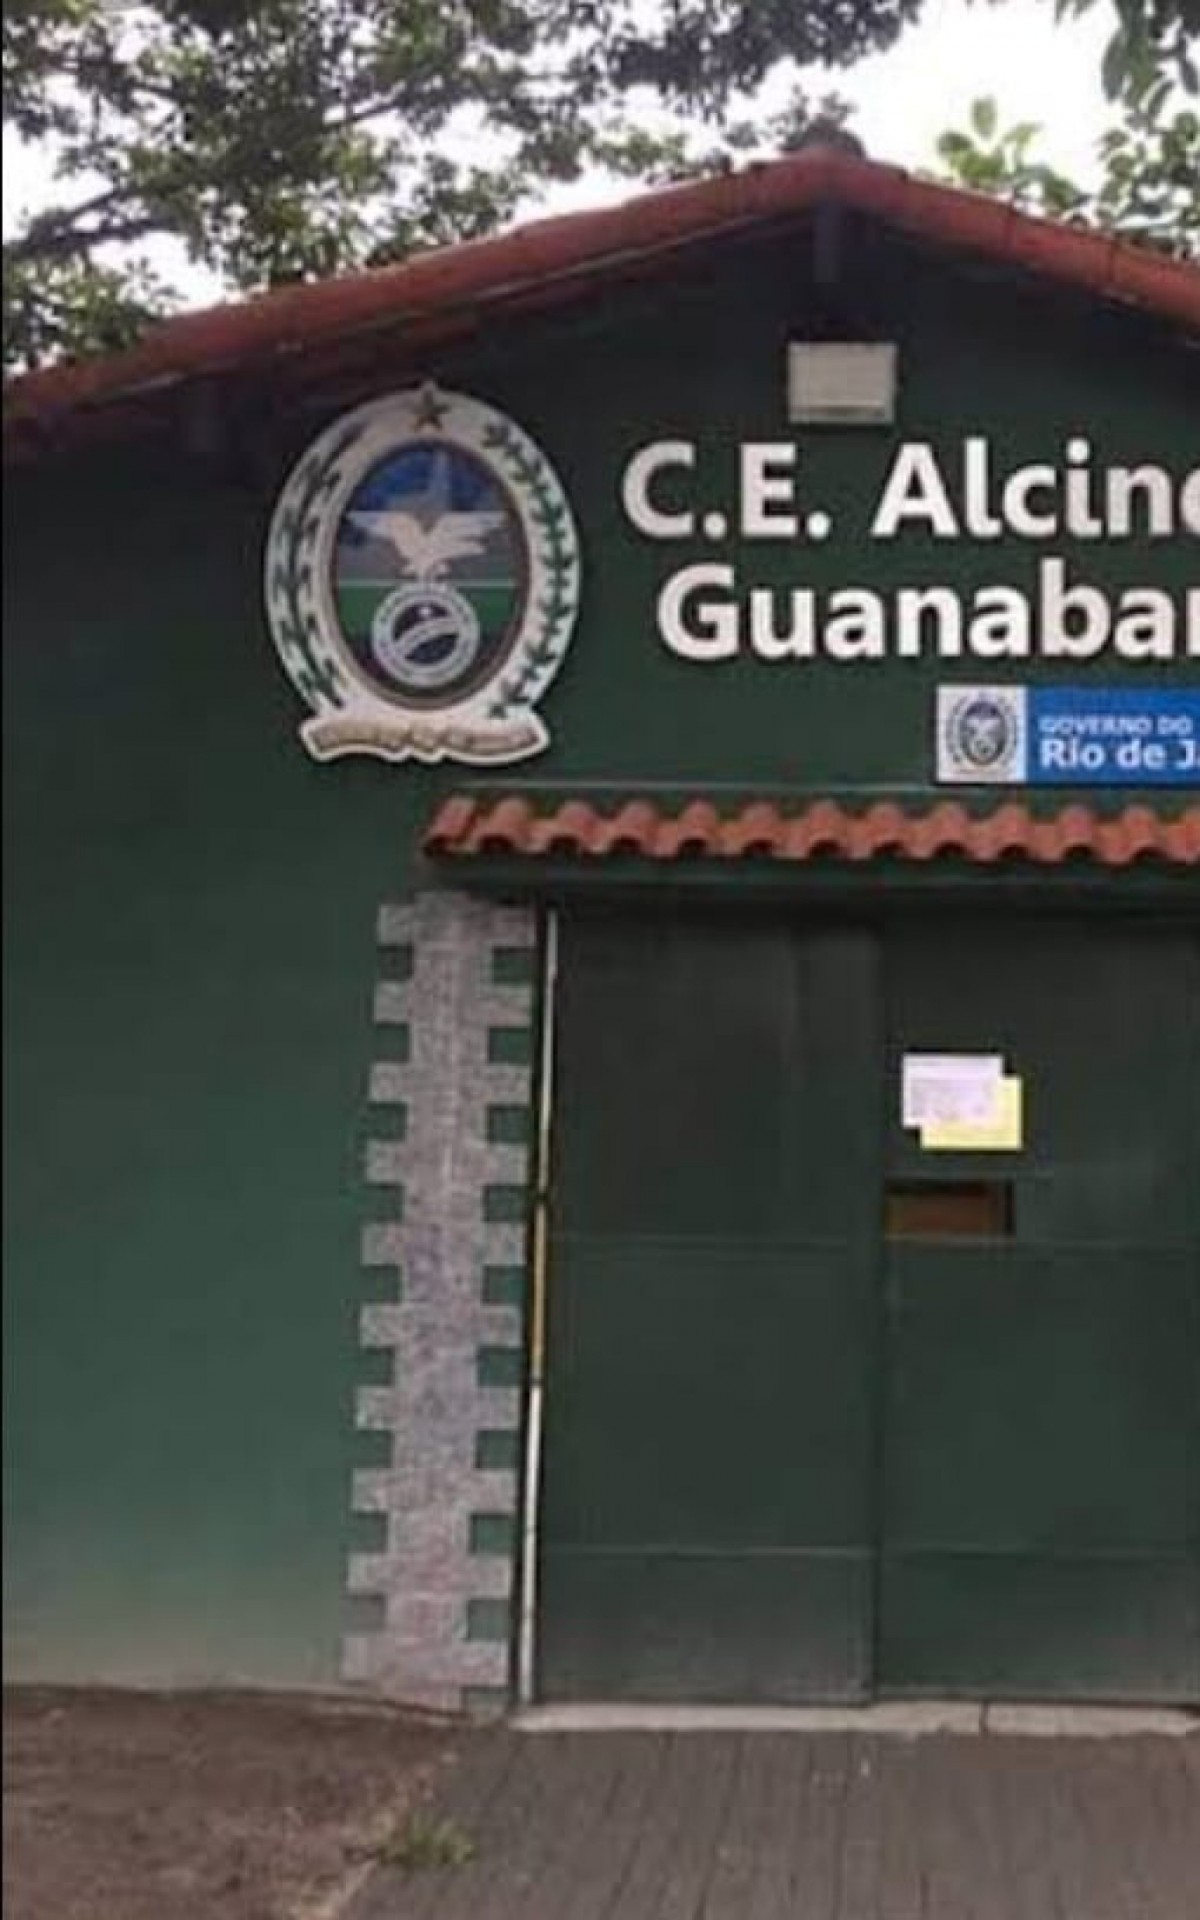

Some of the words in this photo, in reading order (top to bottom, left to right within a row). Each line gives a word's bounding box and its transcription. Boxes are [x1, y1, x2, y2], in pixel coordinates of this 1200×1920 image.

[622, 440, 832, 539] C.E.
[1038, 715, 1153, 735] GOVERNO
[1157, 715, 1194, 735] DO
[1040, 738, 1104, 769] Rio
[1116, 737, 1167, 769] de
[1175, 739, 1200, 769] J
